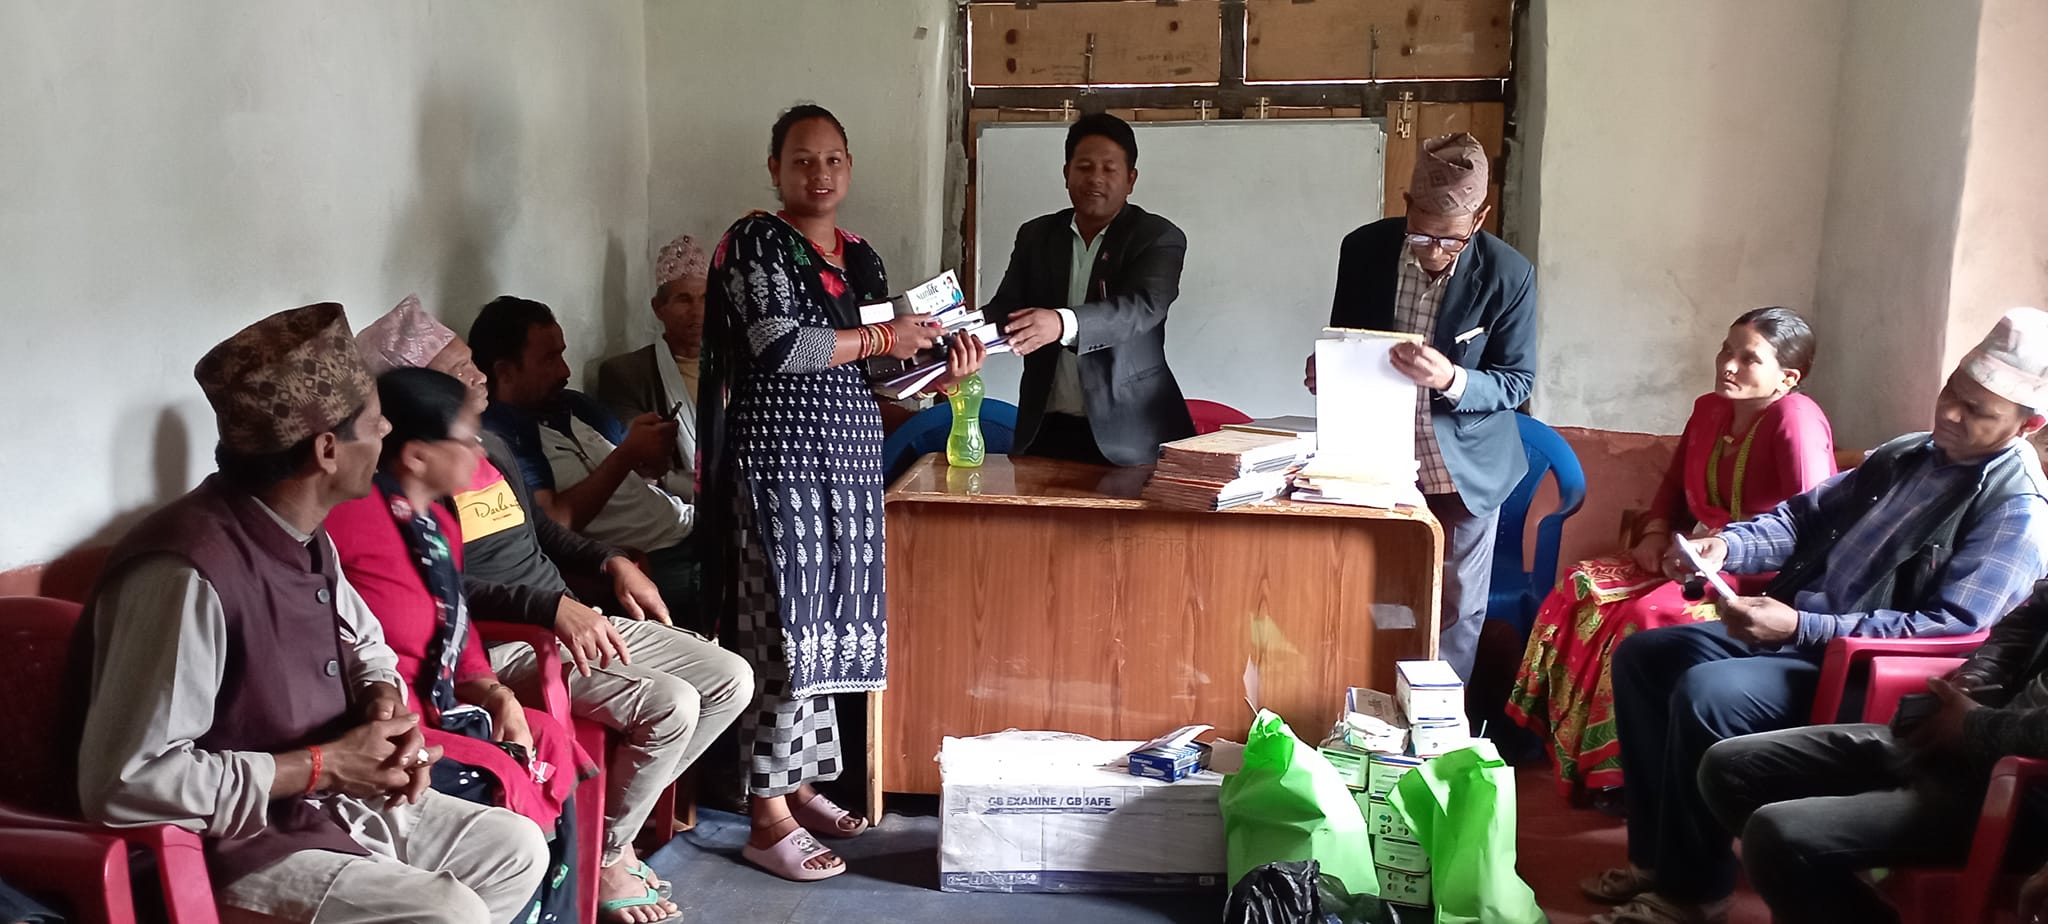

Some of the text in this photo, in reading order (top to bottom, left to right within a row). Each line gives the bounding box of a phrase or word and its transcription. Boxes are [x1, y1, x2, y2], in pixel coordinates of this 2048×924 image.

[988, 796, 1004, 806] GB
[1006, 796, 1057, 806] EXAMINE
[1066, 797, 1082, 806] GB
[1085, 797, 1112, 806] SAFE
